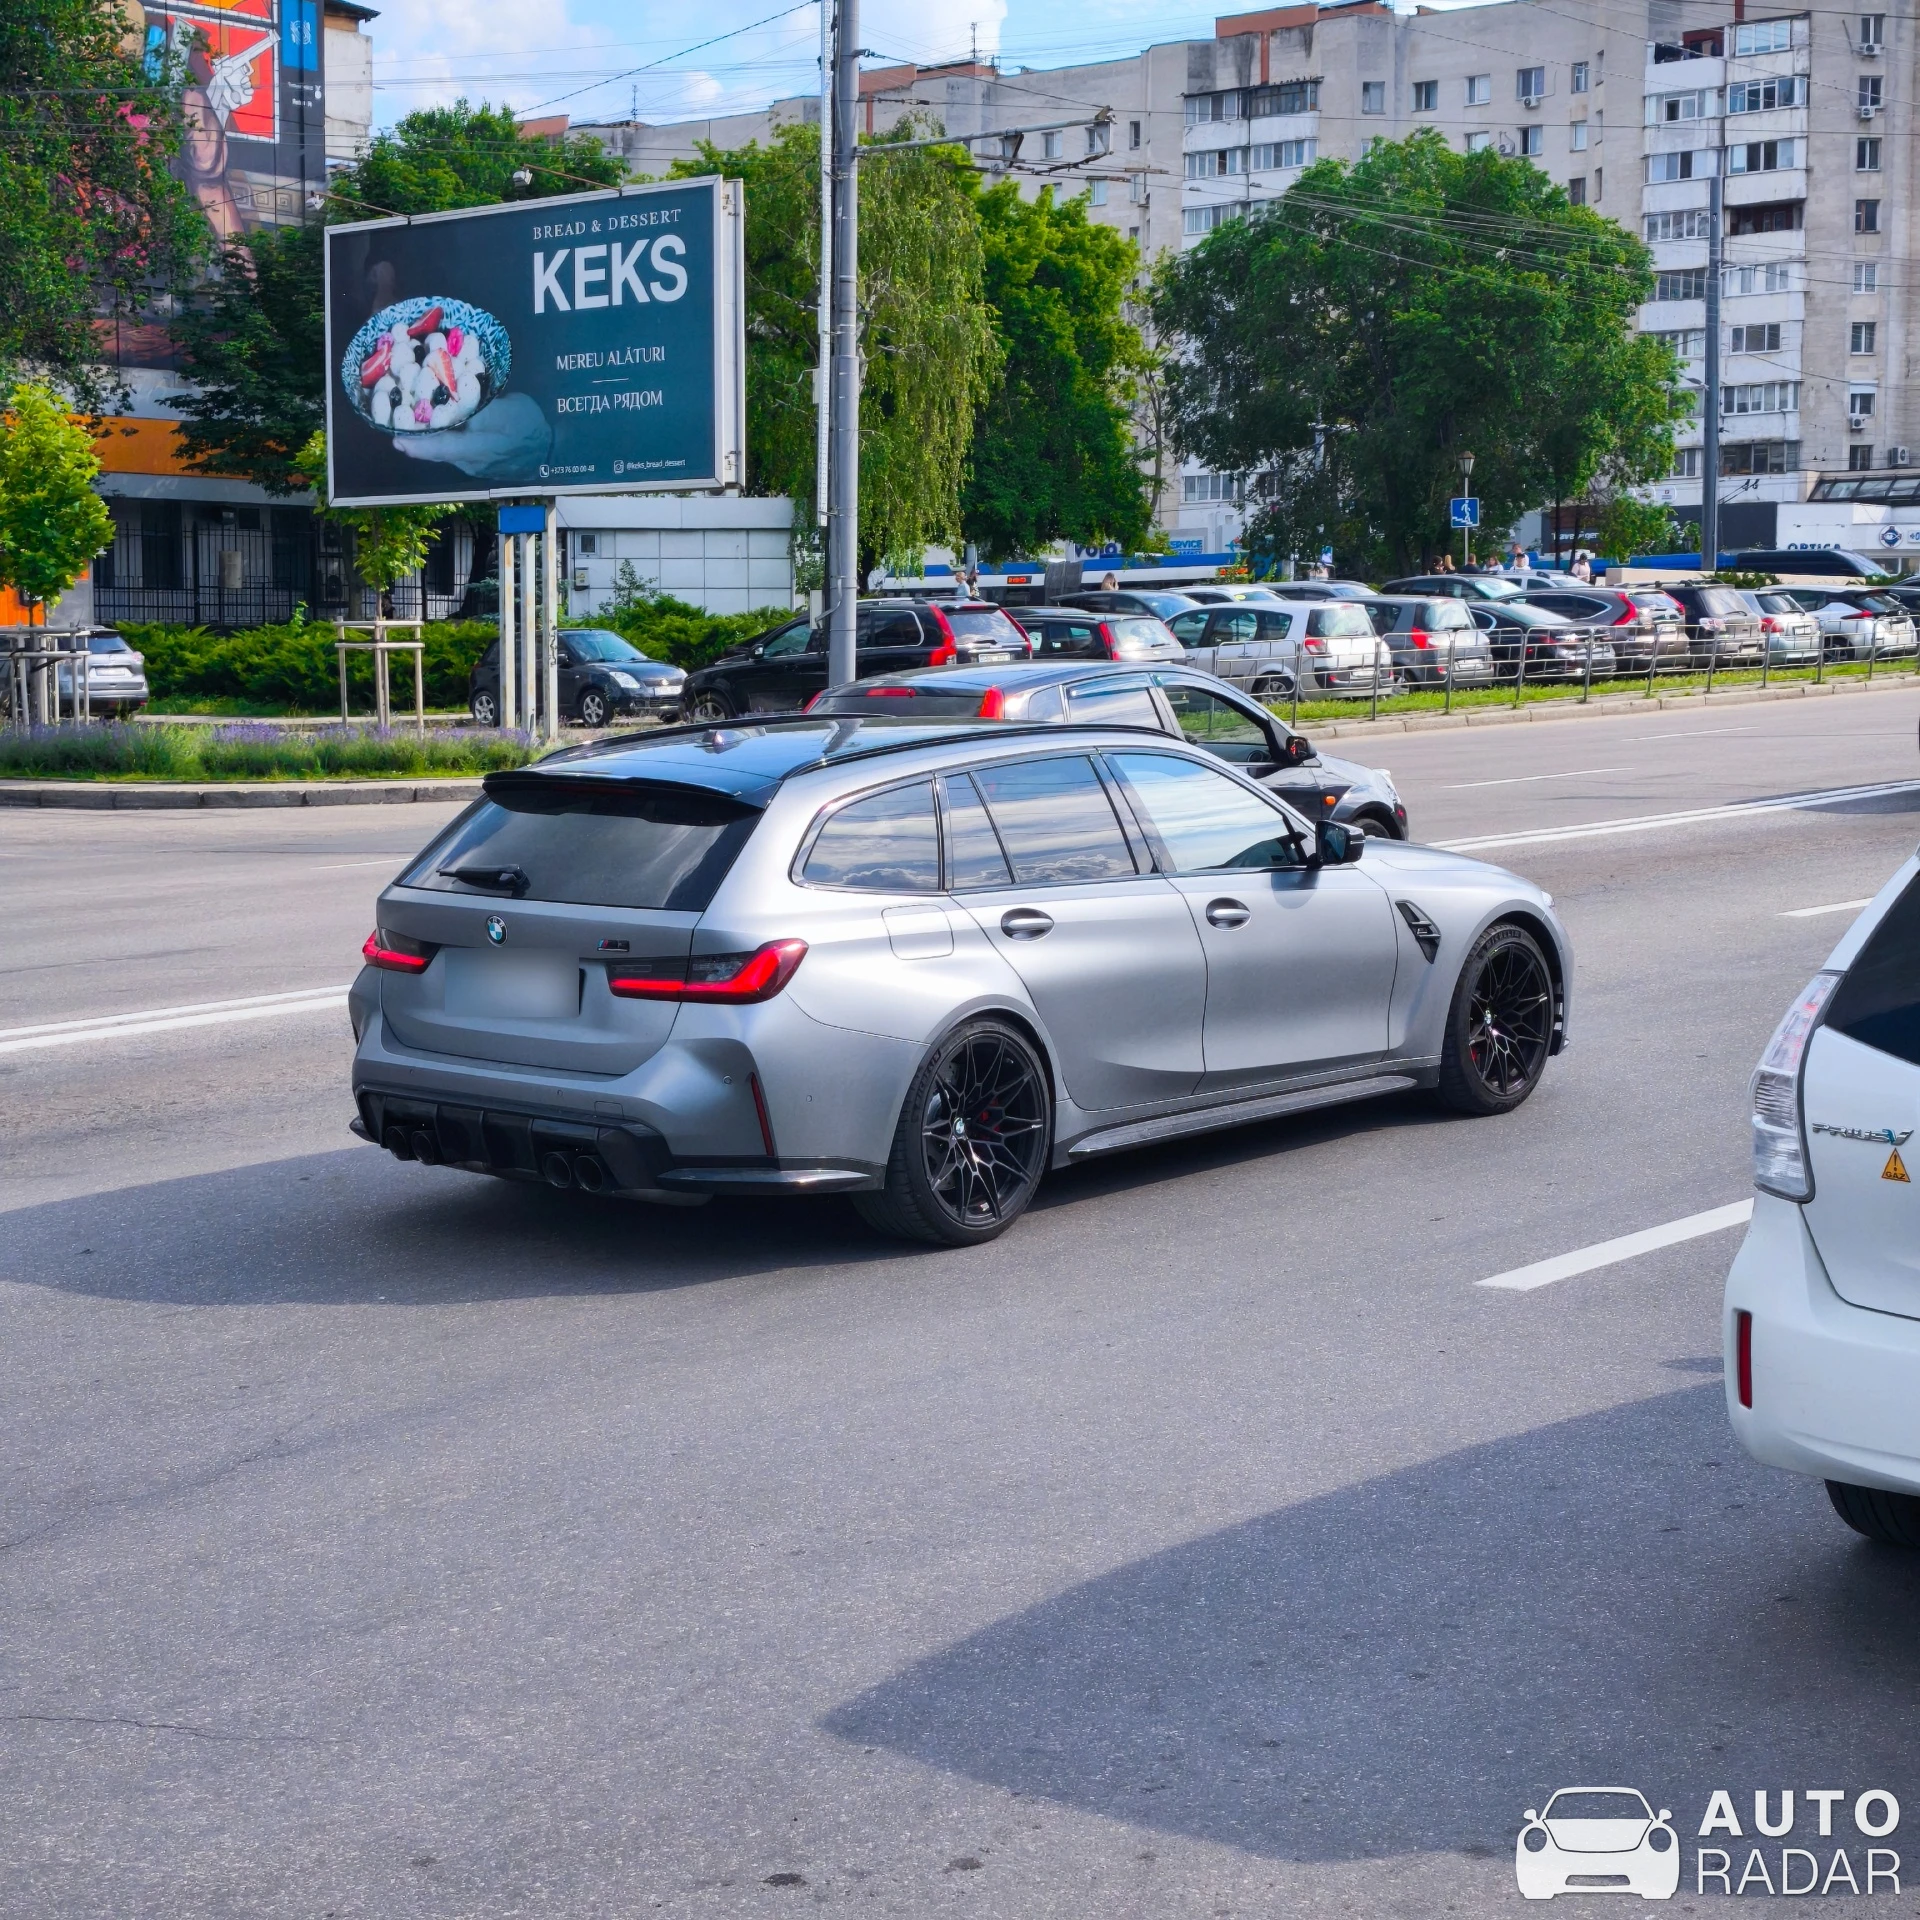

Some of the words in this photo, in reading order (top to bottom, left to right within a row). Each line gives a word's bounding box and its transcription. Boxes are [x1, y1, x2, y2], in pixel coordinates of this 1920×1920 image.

[533, 221, 586, 240] BREAD
[591, 219, 602, 232] &
[608, 208, 682, 231] DESSERT
[533, 234, 688, 315] KEKS
[556, 352, 604, 371] MEREU
[607, 346, 666, 366] ALĂTURI
[557, 395, 611, 414] ВСЕГДА
[614, 390, 664, 411] РЯДОМ
[1885, 1171, 1906, 1180] GAZ
